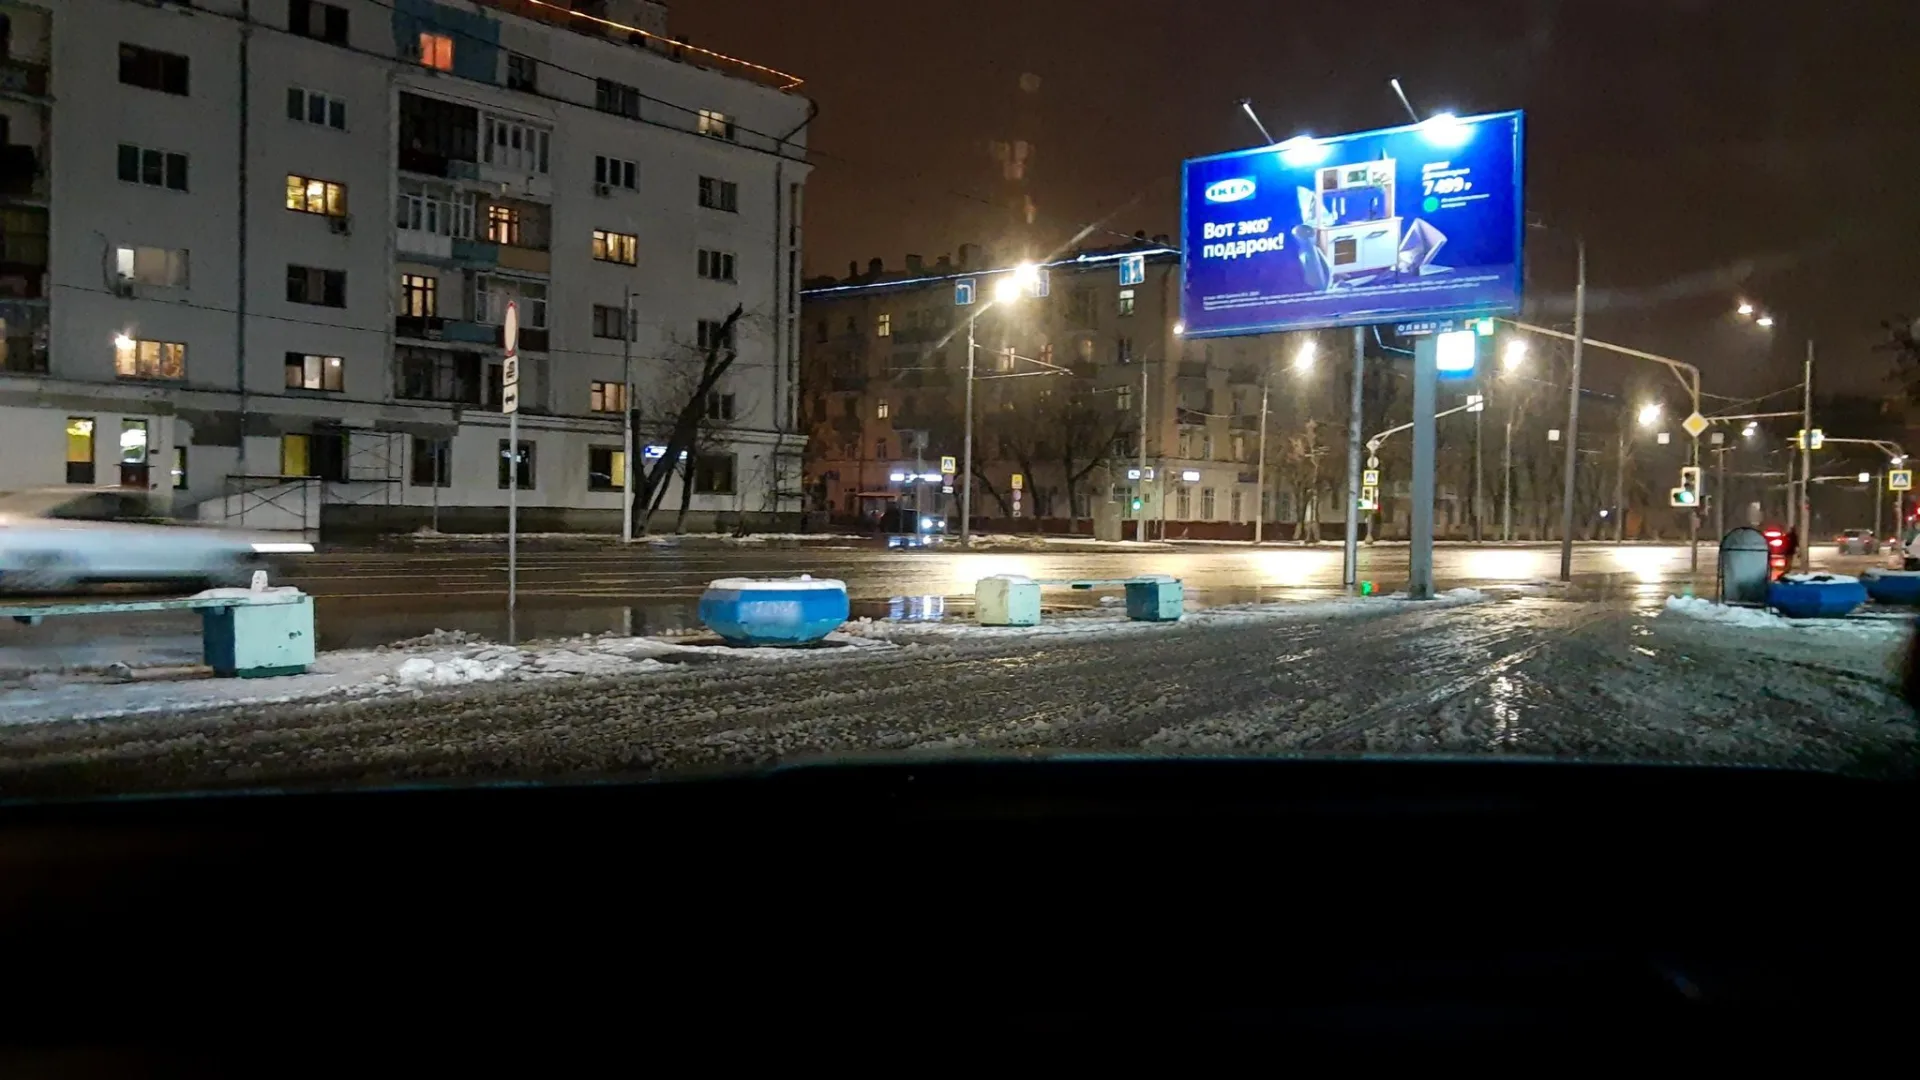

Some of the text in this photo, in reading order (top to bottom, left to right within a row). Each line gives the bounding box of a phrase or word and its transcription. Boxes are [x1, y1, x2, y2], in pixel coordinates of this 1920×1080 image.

[1211, 185, 1249, 196] IKEA
[1204, 222, 1235, 239] Вот
[1203, 233, 1284, 260] подарок!
